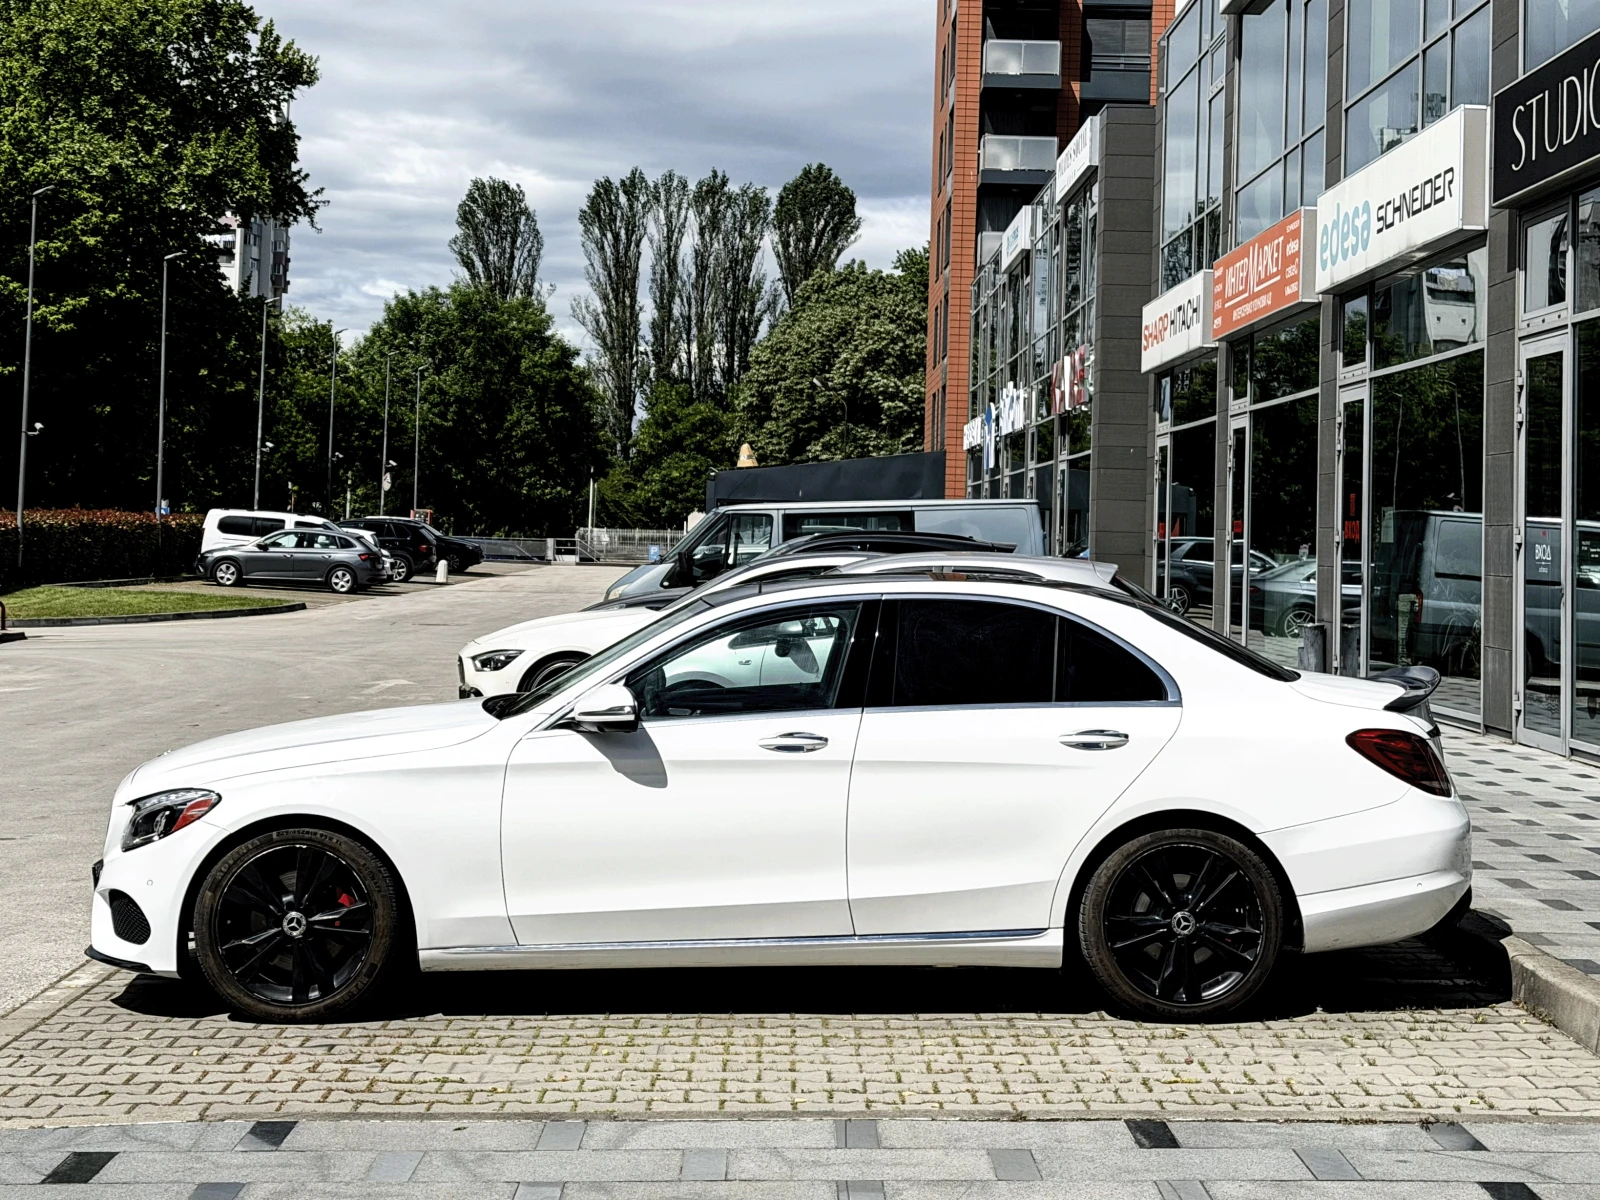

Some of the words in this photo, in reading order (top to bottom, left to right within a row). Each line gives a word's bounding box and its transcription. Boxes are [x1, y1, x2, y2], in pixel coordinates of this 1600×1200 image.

[1320, 200, 1371, 271] edesa
[1376, 166, 1454, 234] SCHNEIDER
[1143, 313, 1169, 352] SHARP
[1169, 294, 1201, 338] HITACHI
[1535, 543, 1552, 561] ВХОД
